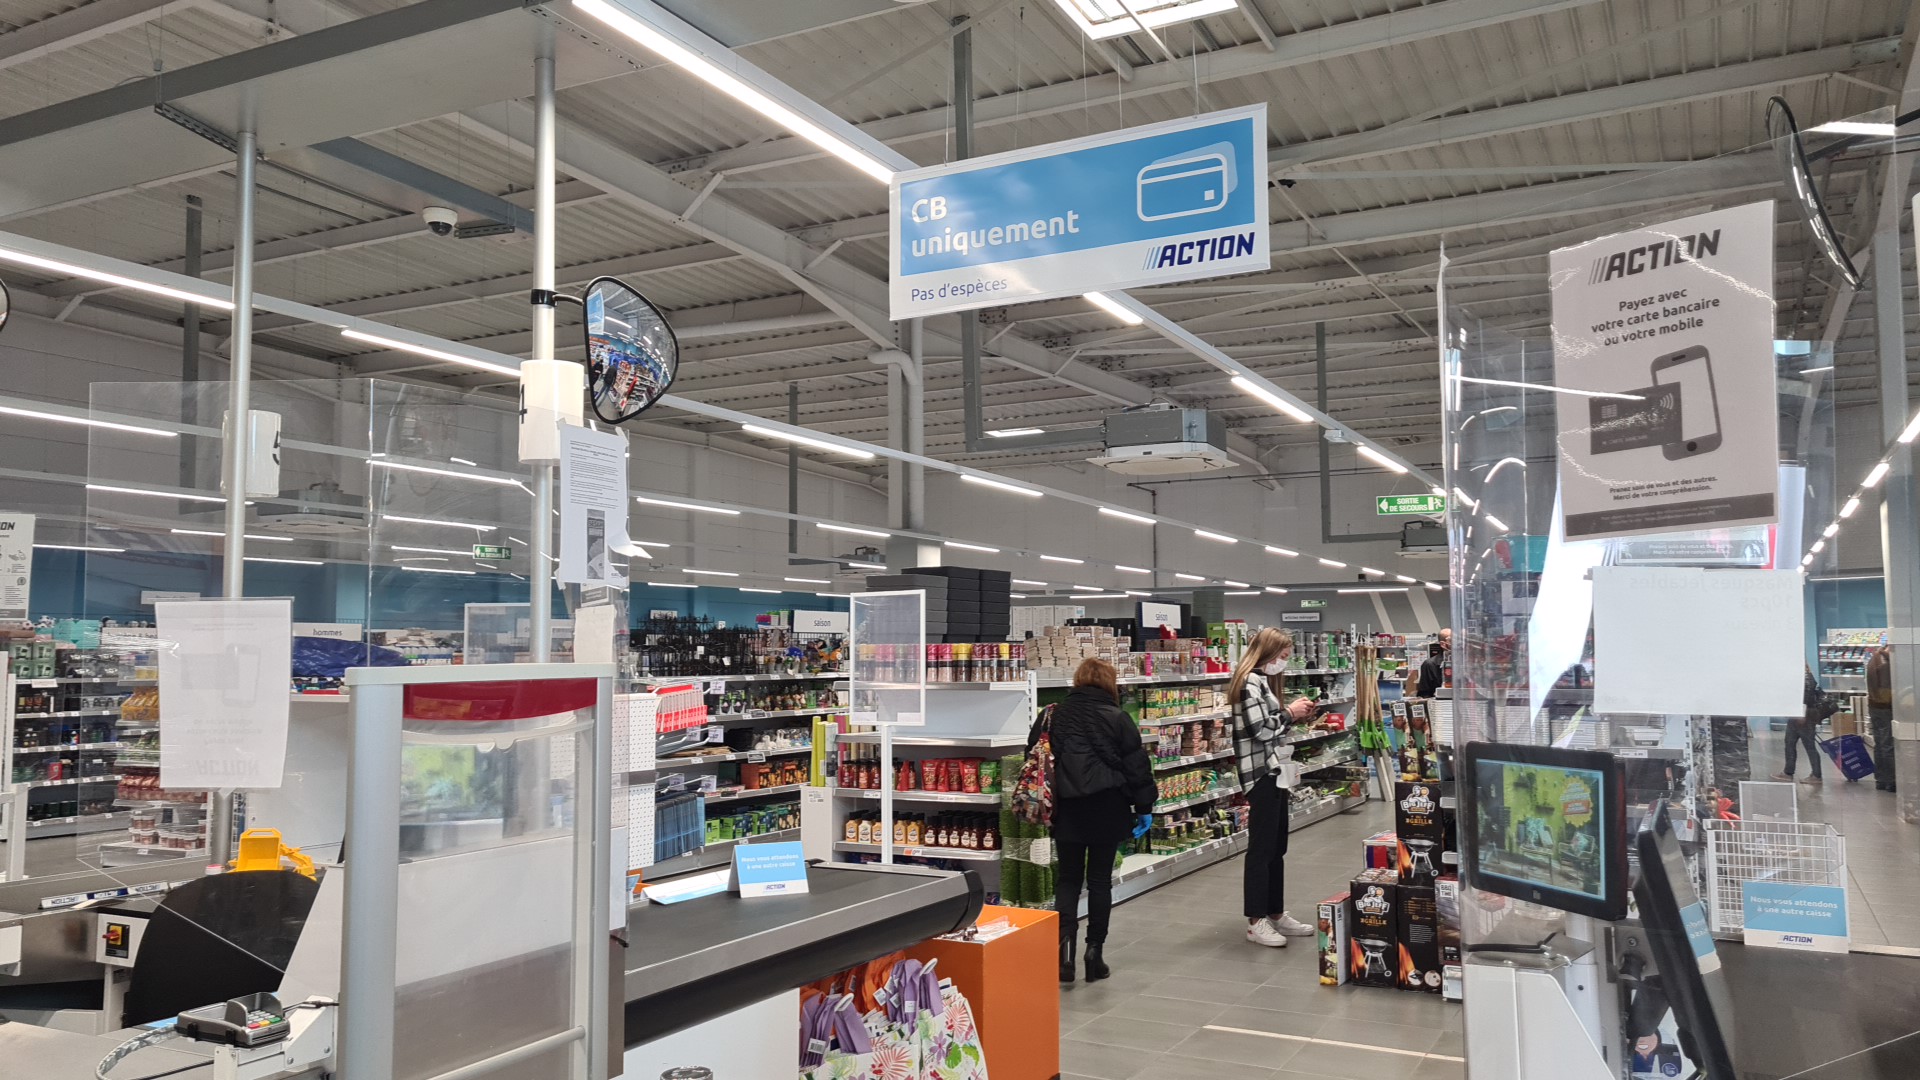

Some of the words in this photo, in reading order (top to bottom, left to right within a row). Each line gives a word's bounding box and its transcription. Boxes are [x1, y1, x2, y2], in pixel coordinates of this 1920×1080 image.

[911, 195, 948, 223] CB
[911, 209, 1080, 258] uniquement
[1157, 232, 1255, 268] ACTION
[1604, 229, 1721, 281] ACTION
[911, 286, 935, 302] Pas
[938, 277, 1007, 300] d'espèces
[1619, 296, 1655, 311] Payez
[1657, 288, 1688, 303] avec
[1591, 319, 1624, 333] votre
[1627, 311, 1660, 326] carte
[1662, 298, 1720, 318] bancaire
[1604, 336, 1619, 346] ou
[1622, 328, 1656, 342] votre
[1659, 317, 1704, 335] mobile
[1693, 476, 1718, 484] autres.
[1397, 497, 1419, 505] SORTIE
[1399, 504, 1428, 512] SECOURS
[813, 618, 832, 627] saison
[313, 627, 343, 637] hommes
[1750, 895, 1772, 904] Nous
[1773, 898, 1793, 906] vous
[1794, 900, 1838, 909] attendons
[1781, 907, 1805, 916] autre
[1805, 910, 1832, 918] caisse
[1782, 934, 1813, 944] ACTION
